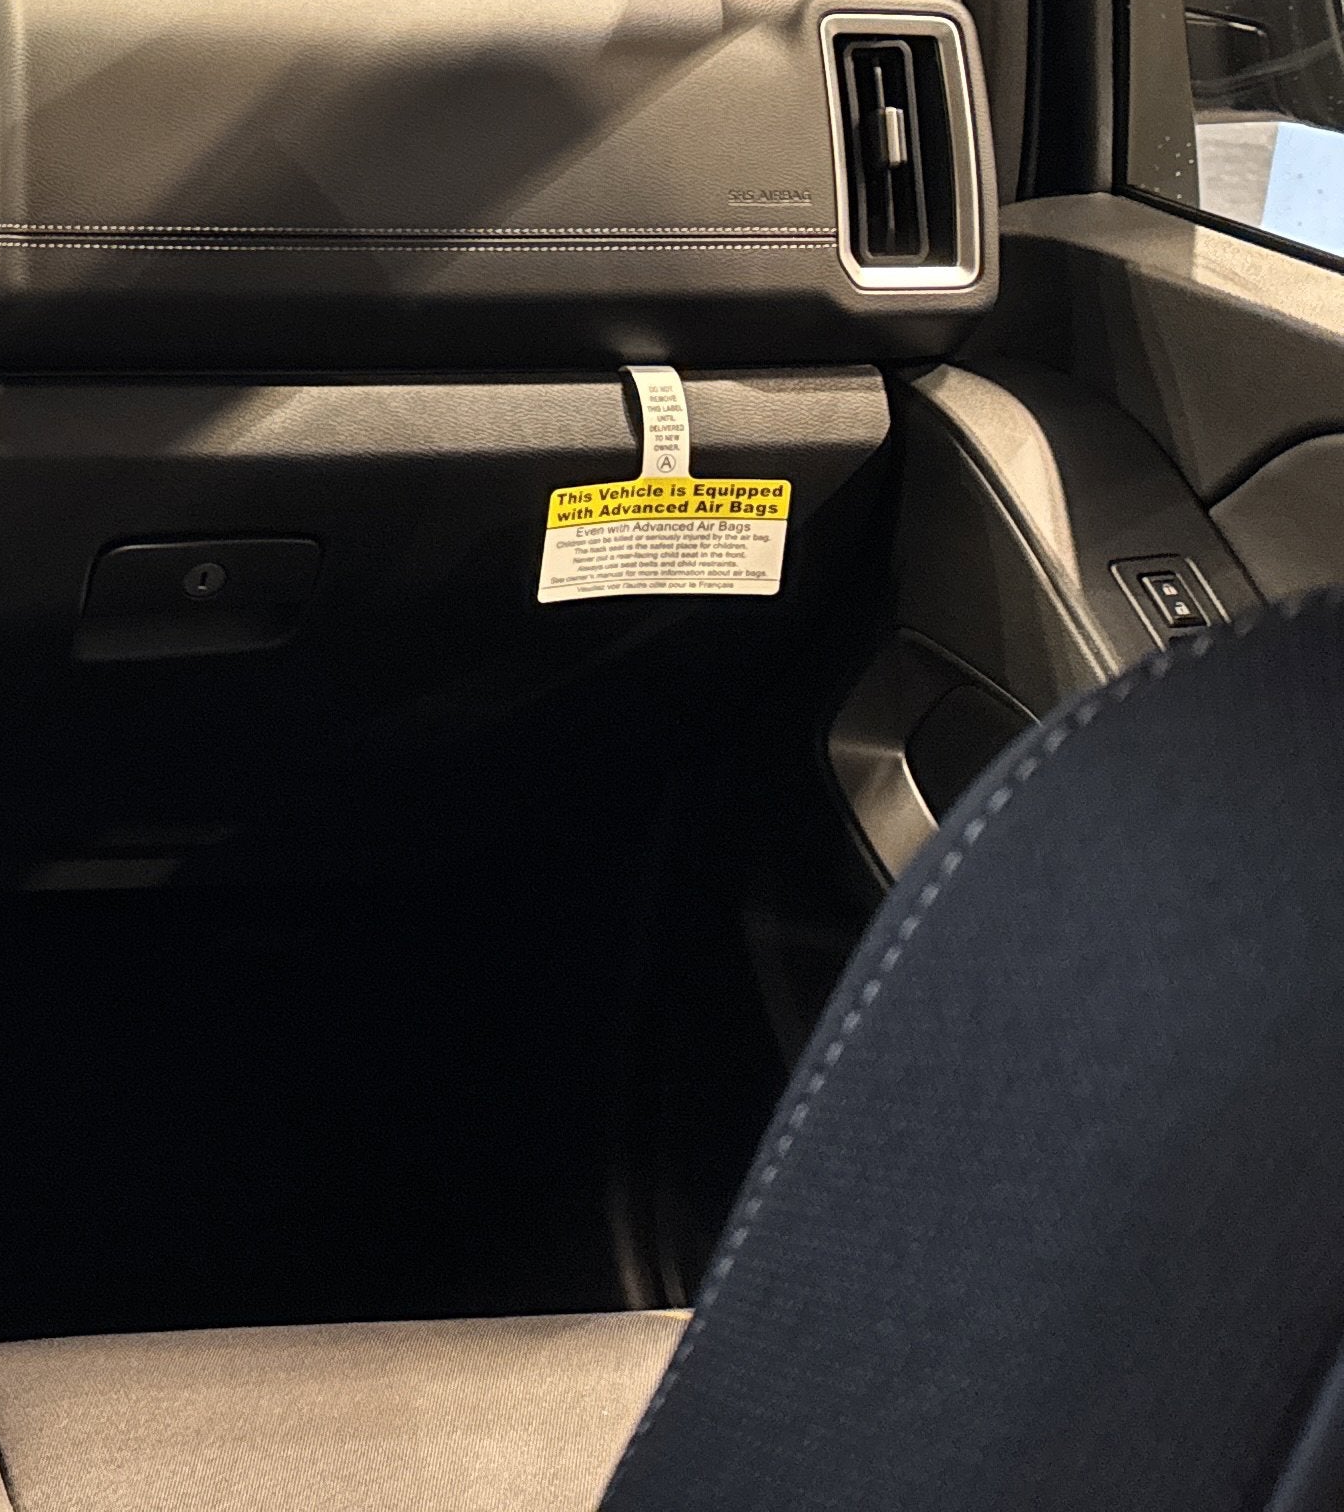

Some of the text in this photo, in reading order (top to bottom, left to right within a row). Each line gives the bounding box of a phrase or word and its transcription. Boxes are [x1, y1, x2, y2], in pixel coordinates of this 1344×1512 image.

[759, 190, 812, 201] AIRBAG
[557, 484, 784, 506] This Vehicle is Equipped
[557, 501, 779, 522] with Advanced Air Bags
[576, 521, 751, 537] Even with Advanced Air Bags
[683, 534, 711, 542] injured
[713, 533, 722, 541] by
